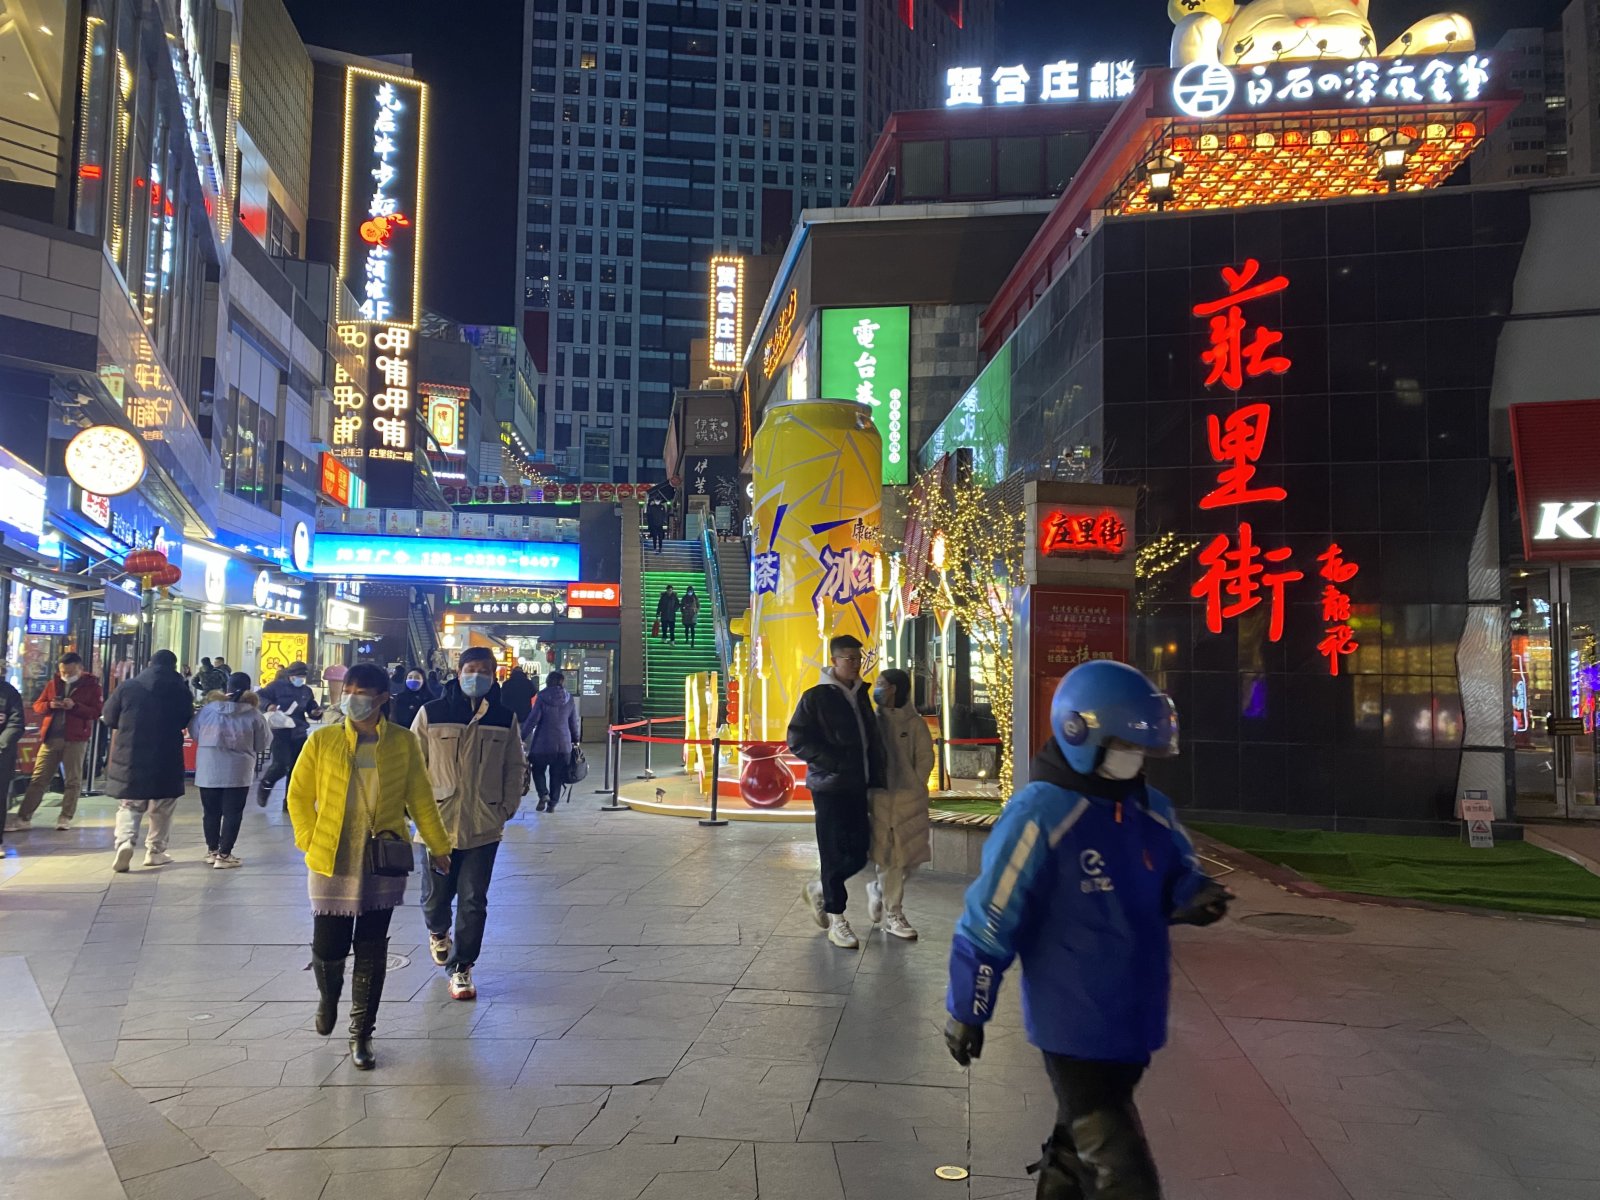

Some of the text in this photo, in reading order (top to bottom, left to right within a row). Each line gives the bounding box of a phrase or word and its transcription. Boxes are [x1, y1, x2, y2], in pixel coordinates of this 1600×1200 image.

[358, 299, 391, 321] 4F
[1047, 513, 1128, 550] 庄里街
[1533, 501, 1600, 540] K
[755, 553, 779, 591] 茶
